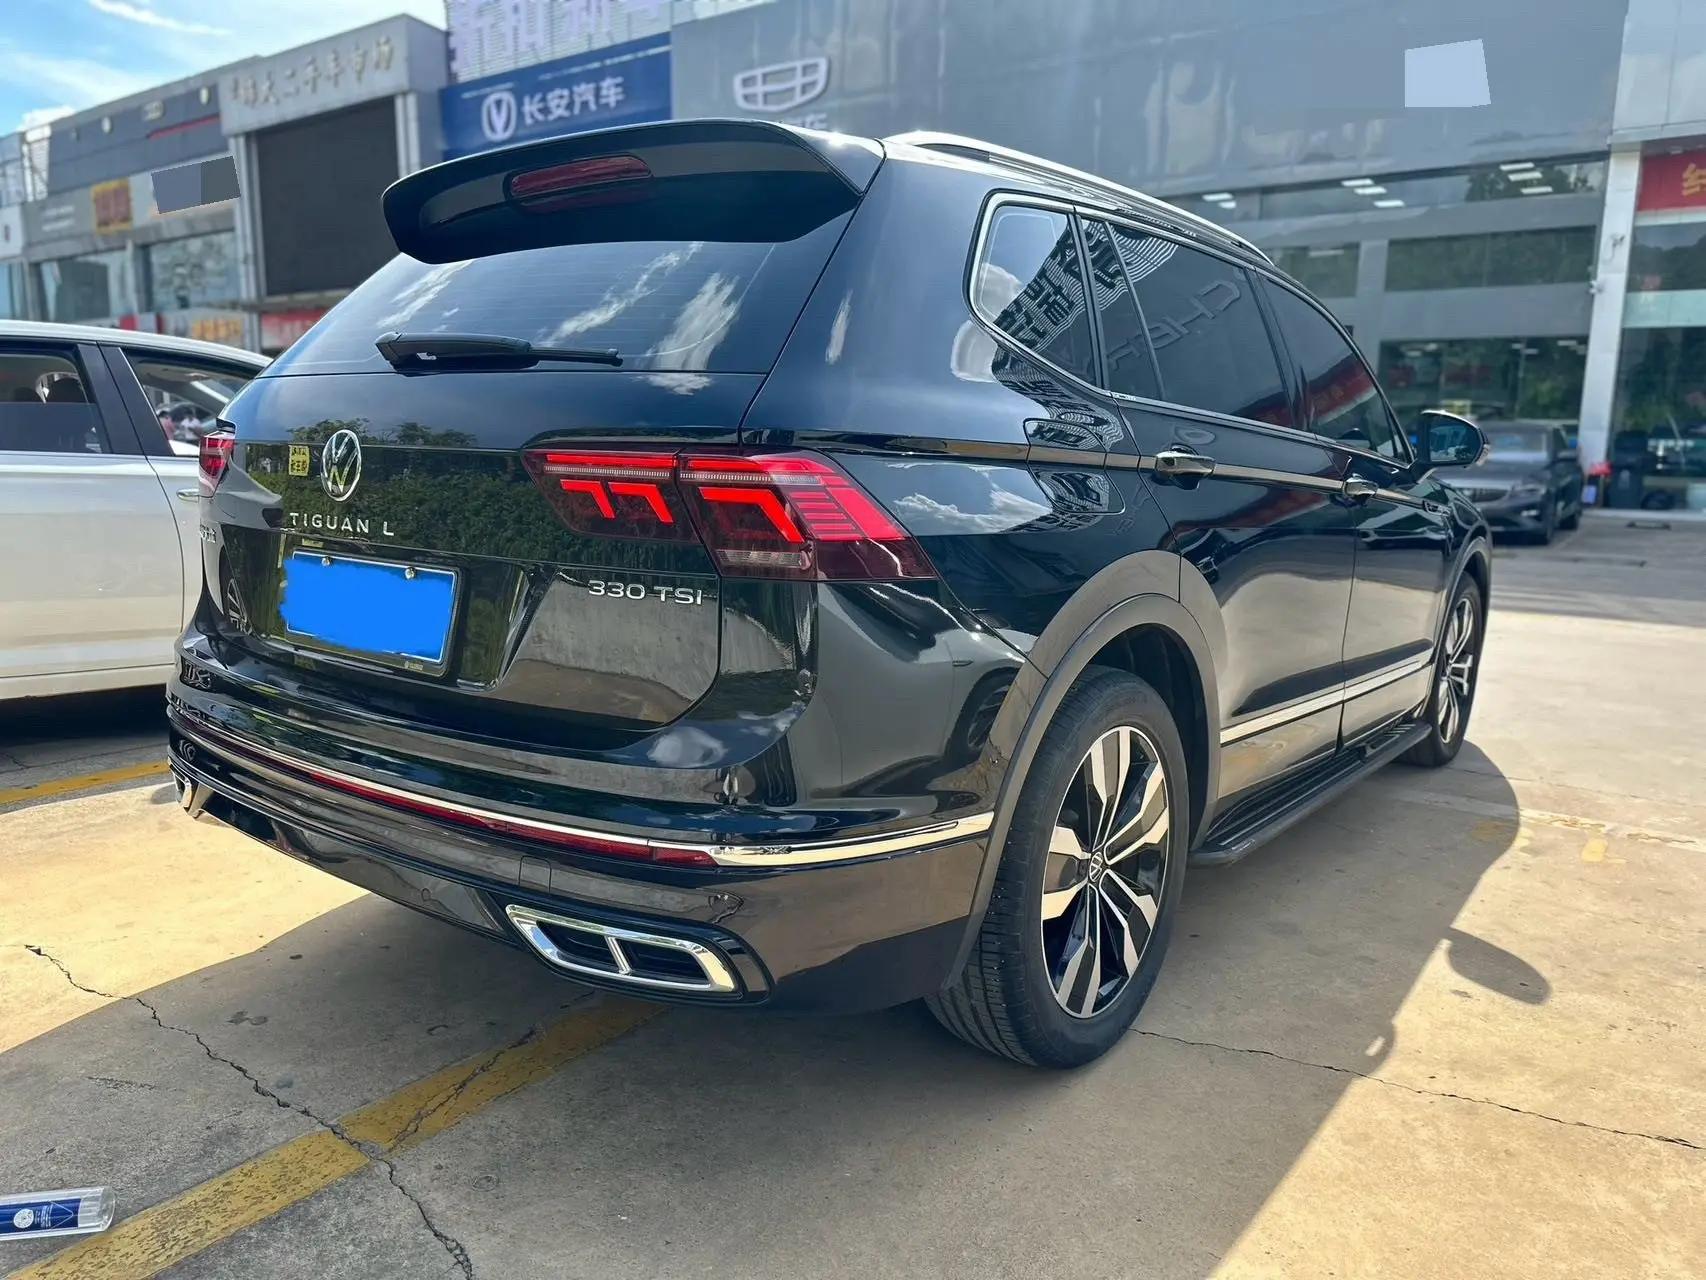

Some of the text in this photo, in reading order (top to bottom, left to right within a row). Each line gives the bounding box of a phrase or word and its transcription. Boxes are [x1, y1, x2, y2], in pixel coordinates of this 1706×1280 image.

[521, 76, 625, 126] 长安汽车
[289, 512, 395, 537] TIGUAN L
[587, 579, 703, 606] 330 TSI
